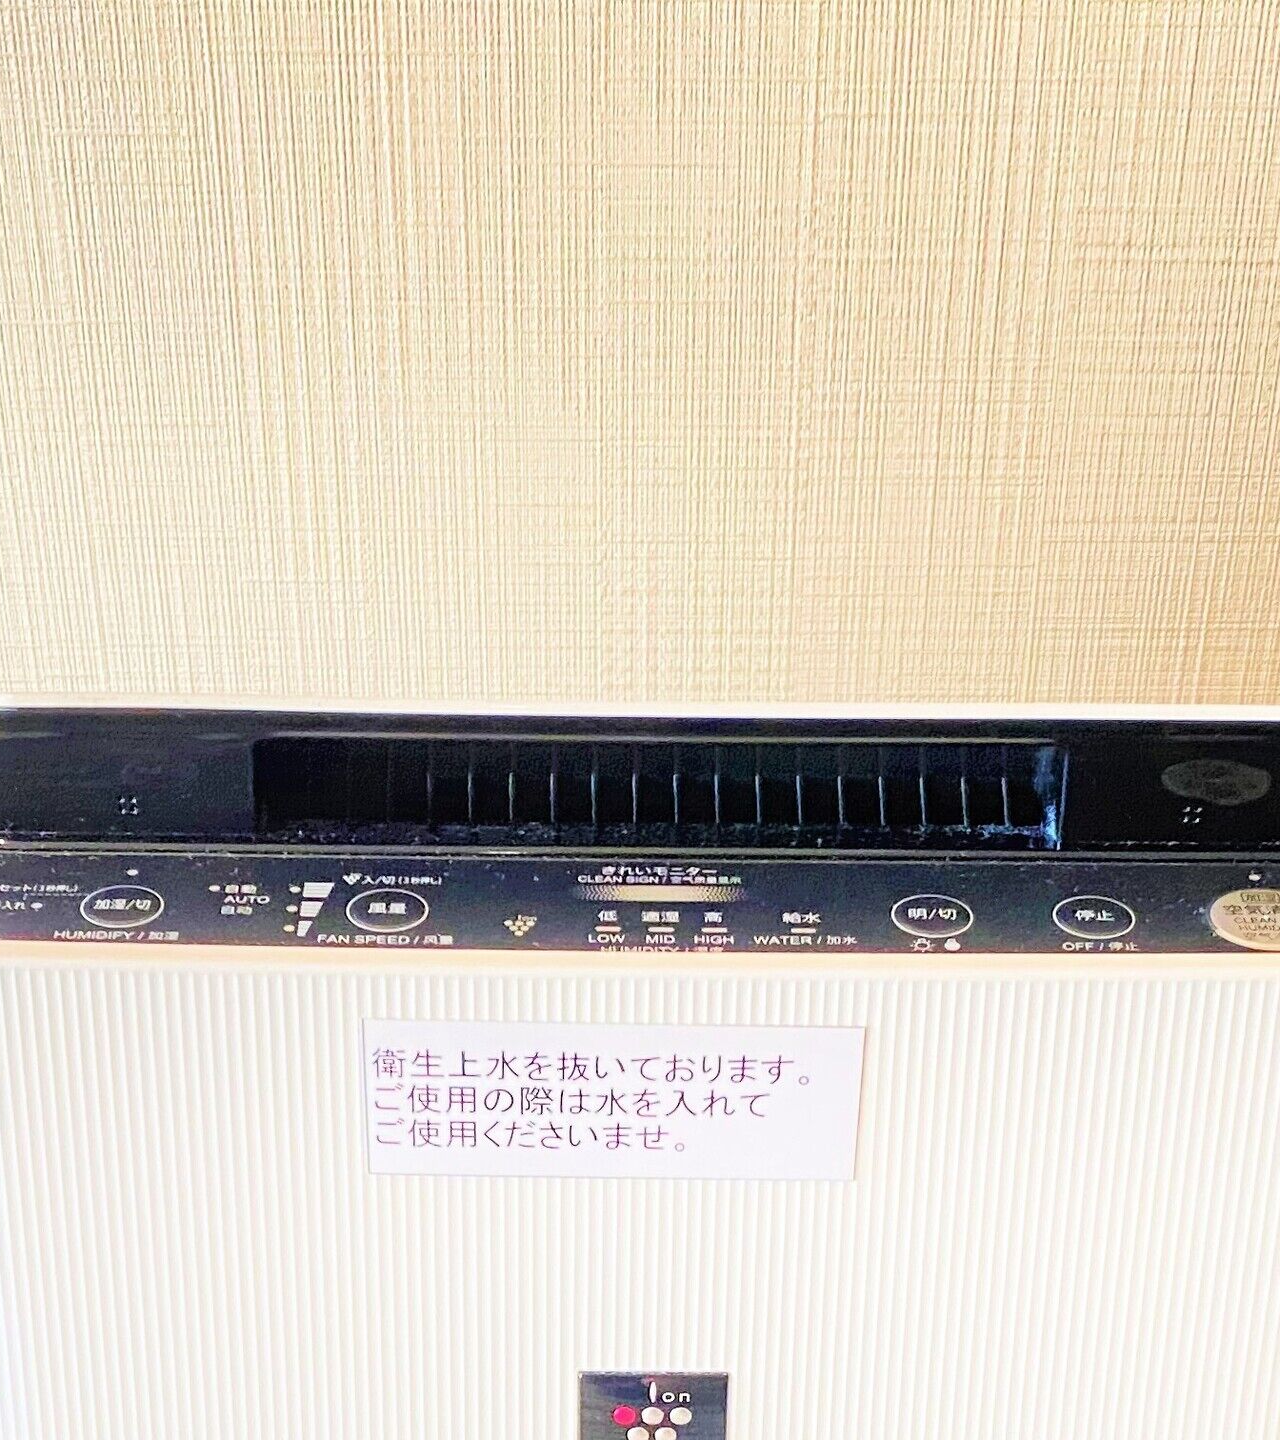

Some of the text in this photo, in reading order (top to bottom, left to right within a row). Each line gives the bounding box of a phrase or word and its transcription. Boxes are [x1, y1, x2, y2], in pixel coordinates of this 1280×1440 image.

[577, 875, 623, 884] CLEAN
[626, 875, 660, 884] SIGN
[223, 895, 270, 904] AUTO
[1074, 909, 1115, 922] 停止
[53, 930, 135, 940] HUMIDIFY
[316, 934, 350, 944] FAN
[354, 934, 411, 945] SPEED
[587, 934, 626, 944] LOW
[645, 934, 676, 944] MID
[693, 934, 735, 944] HIGH
[753, 935, 813, 945] WATER
[1062, 942, 1094, 951] OFF
[371, 1048, 811, 1087] 衛生上水を抜いております。
[373, 1085, 771, 1119] ご使用の際は水を入れて
[375, 1118, 686, 1153] ご使用くださいませ。
